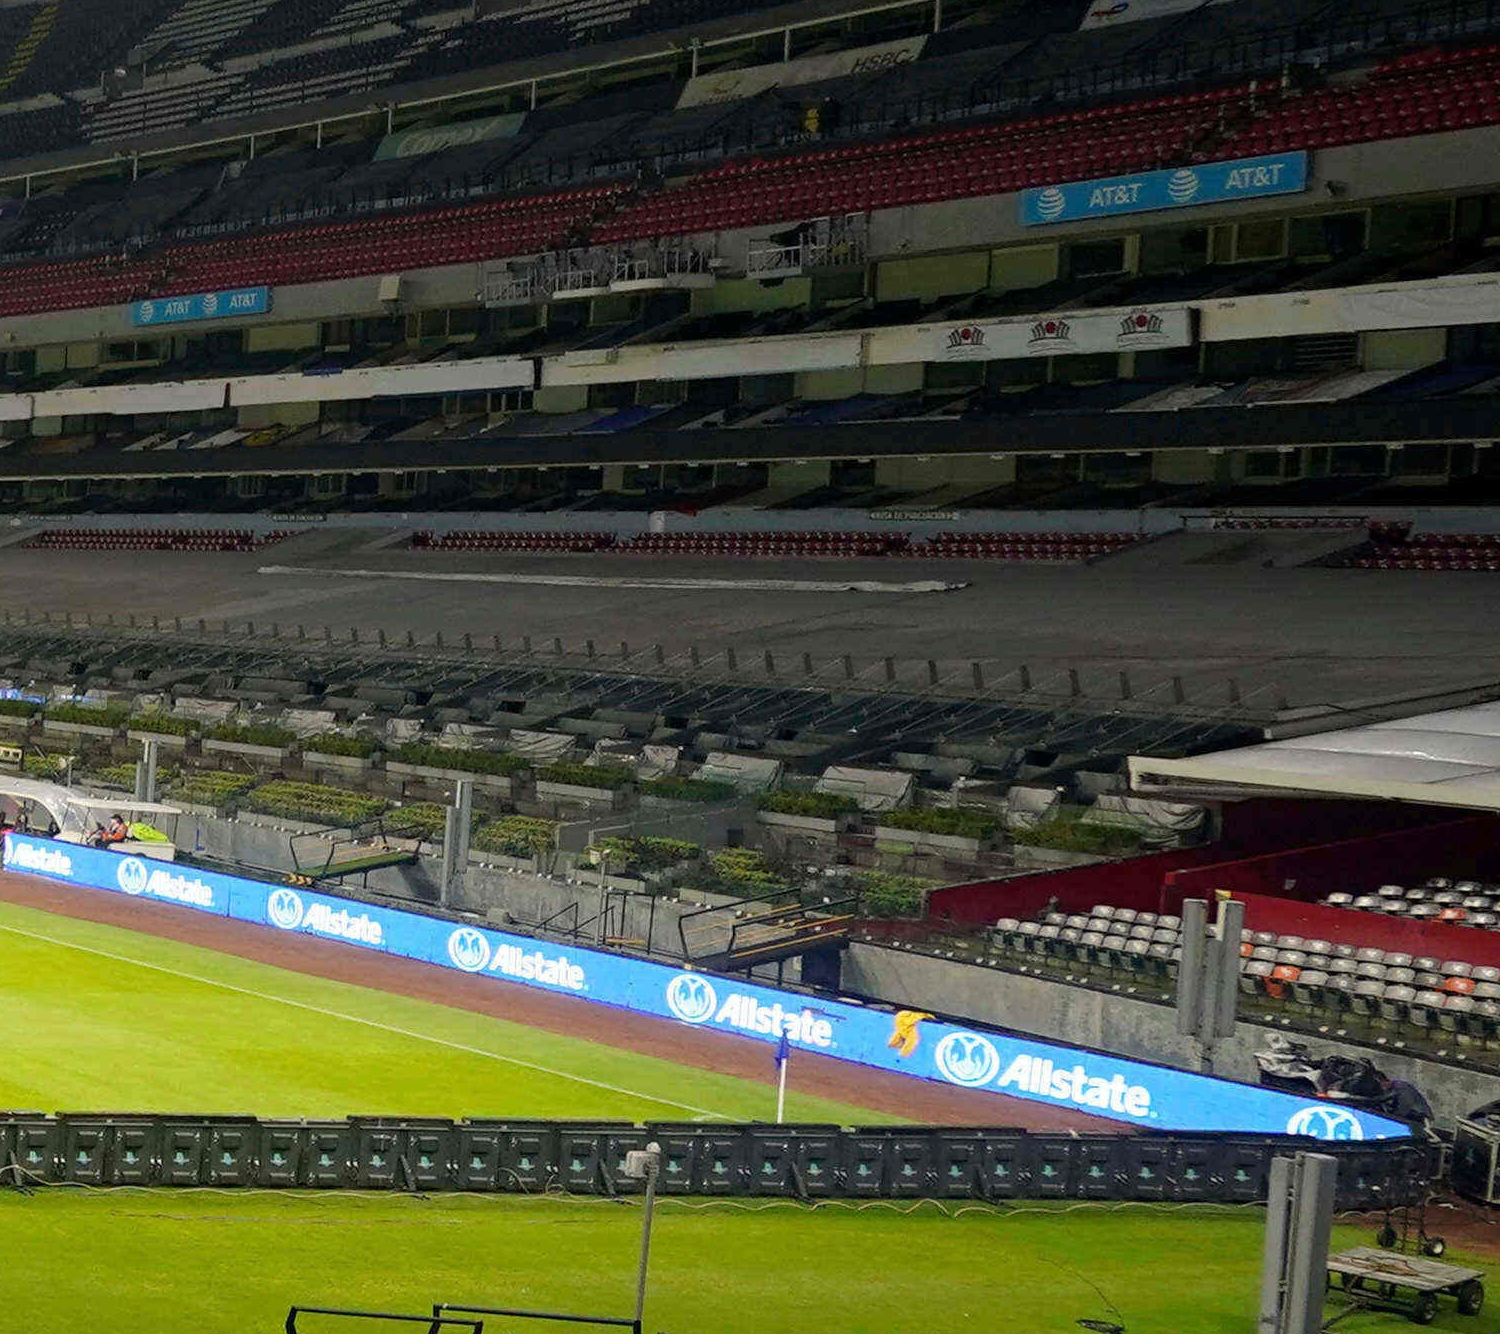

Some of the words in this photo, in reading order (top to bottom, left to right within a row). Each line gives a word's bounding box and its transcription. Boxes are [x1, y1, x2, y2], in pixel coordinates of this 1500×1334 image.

[1089, 182, 1143, 208] AT&T
[1225, 163, 1284, 190] AT&T
[165, 300, 191, 316] AT&T
[230, 293, 258, 308] AT&T
[14, 842, 72, 876] Allstate
[146, 869, 213, 907] Allstate
[302, 902, 382, 945] Allstate
[490, 944, 584, 991] Allstate
[715, 994, 832, 1048] Allstate
[998, 1054, 1151, 1117] Allstate
